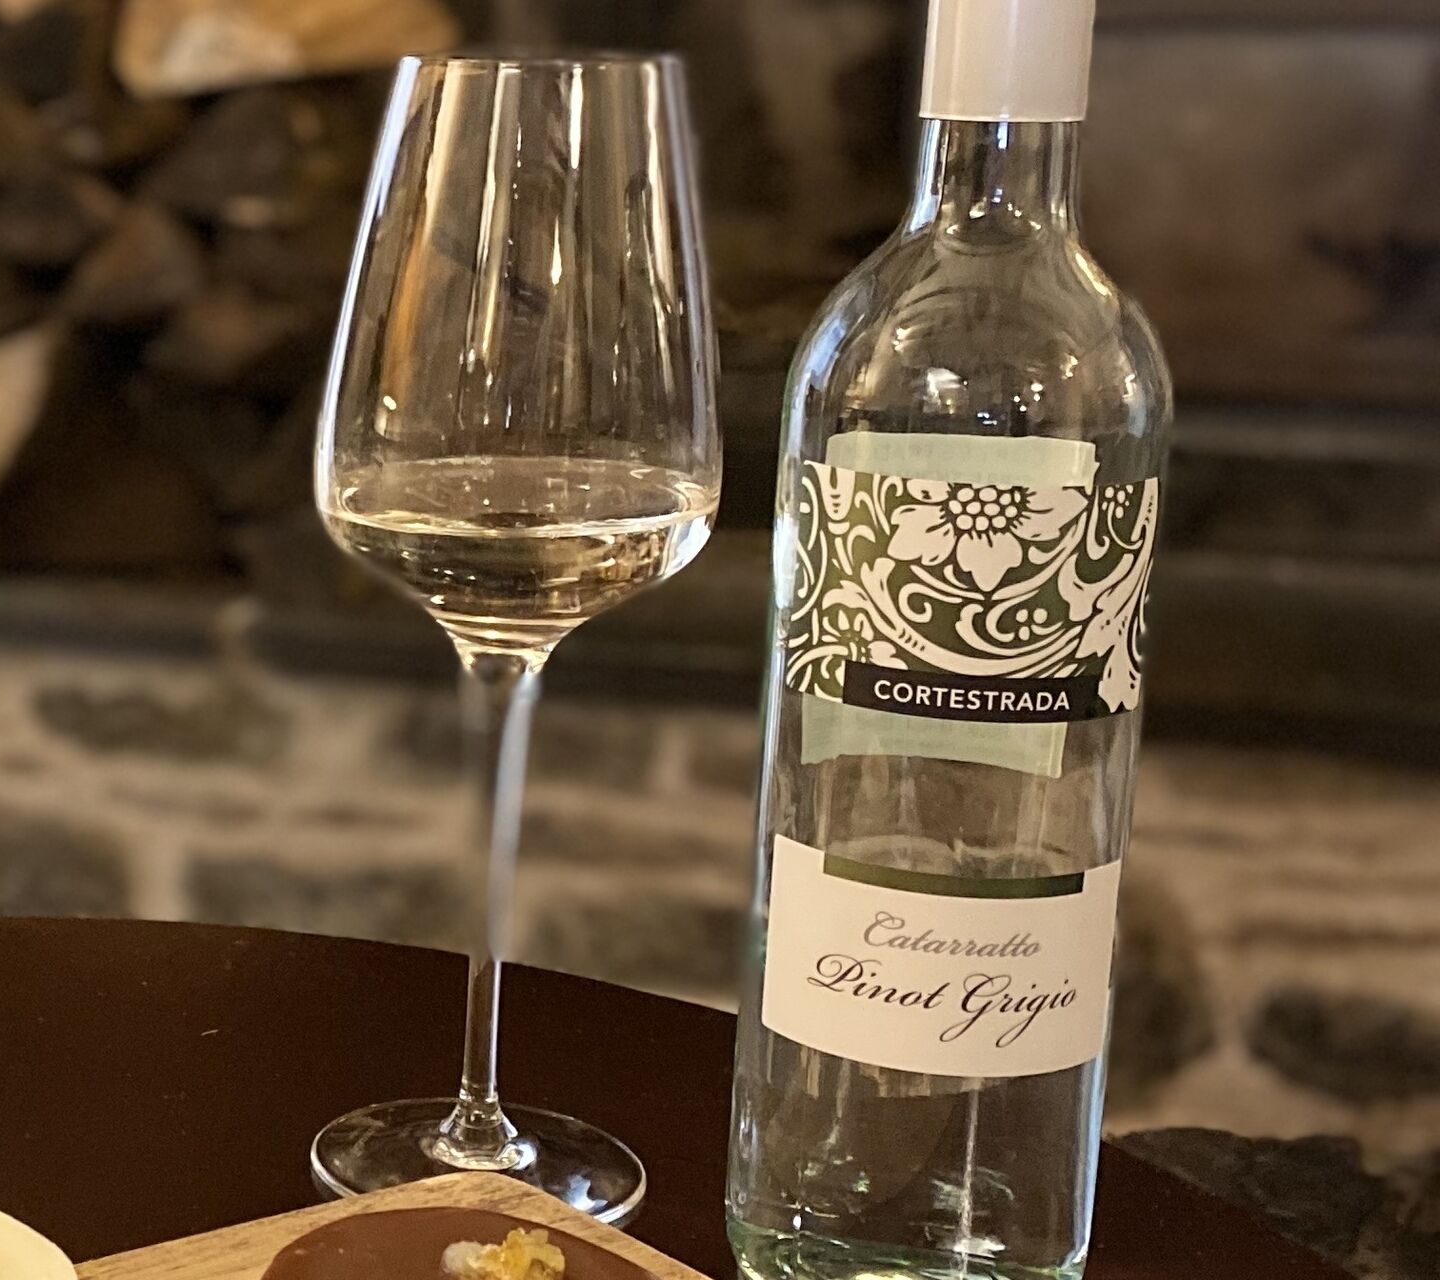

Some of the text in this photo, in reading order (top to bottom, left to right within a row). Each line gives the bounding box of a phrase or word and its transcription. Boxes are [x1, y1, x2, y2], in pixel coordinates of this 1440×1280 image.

[873, 679, 1071, 712] CORTESTRADA
[863, 910, 1041, 958] Catarratto
[806, 953, 1077, 1048] Pinot Grigio
